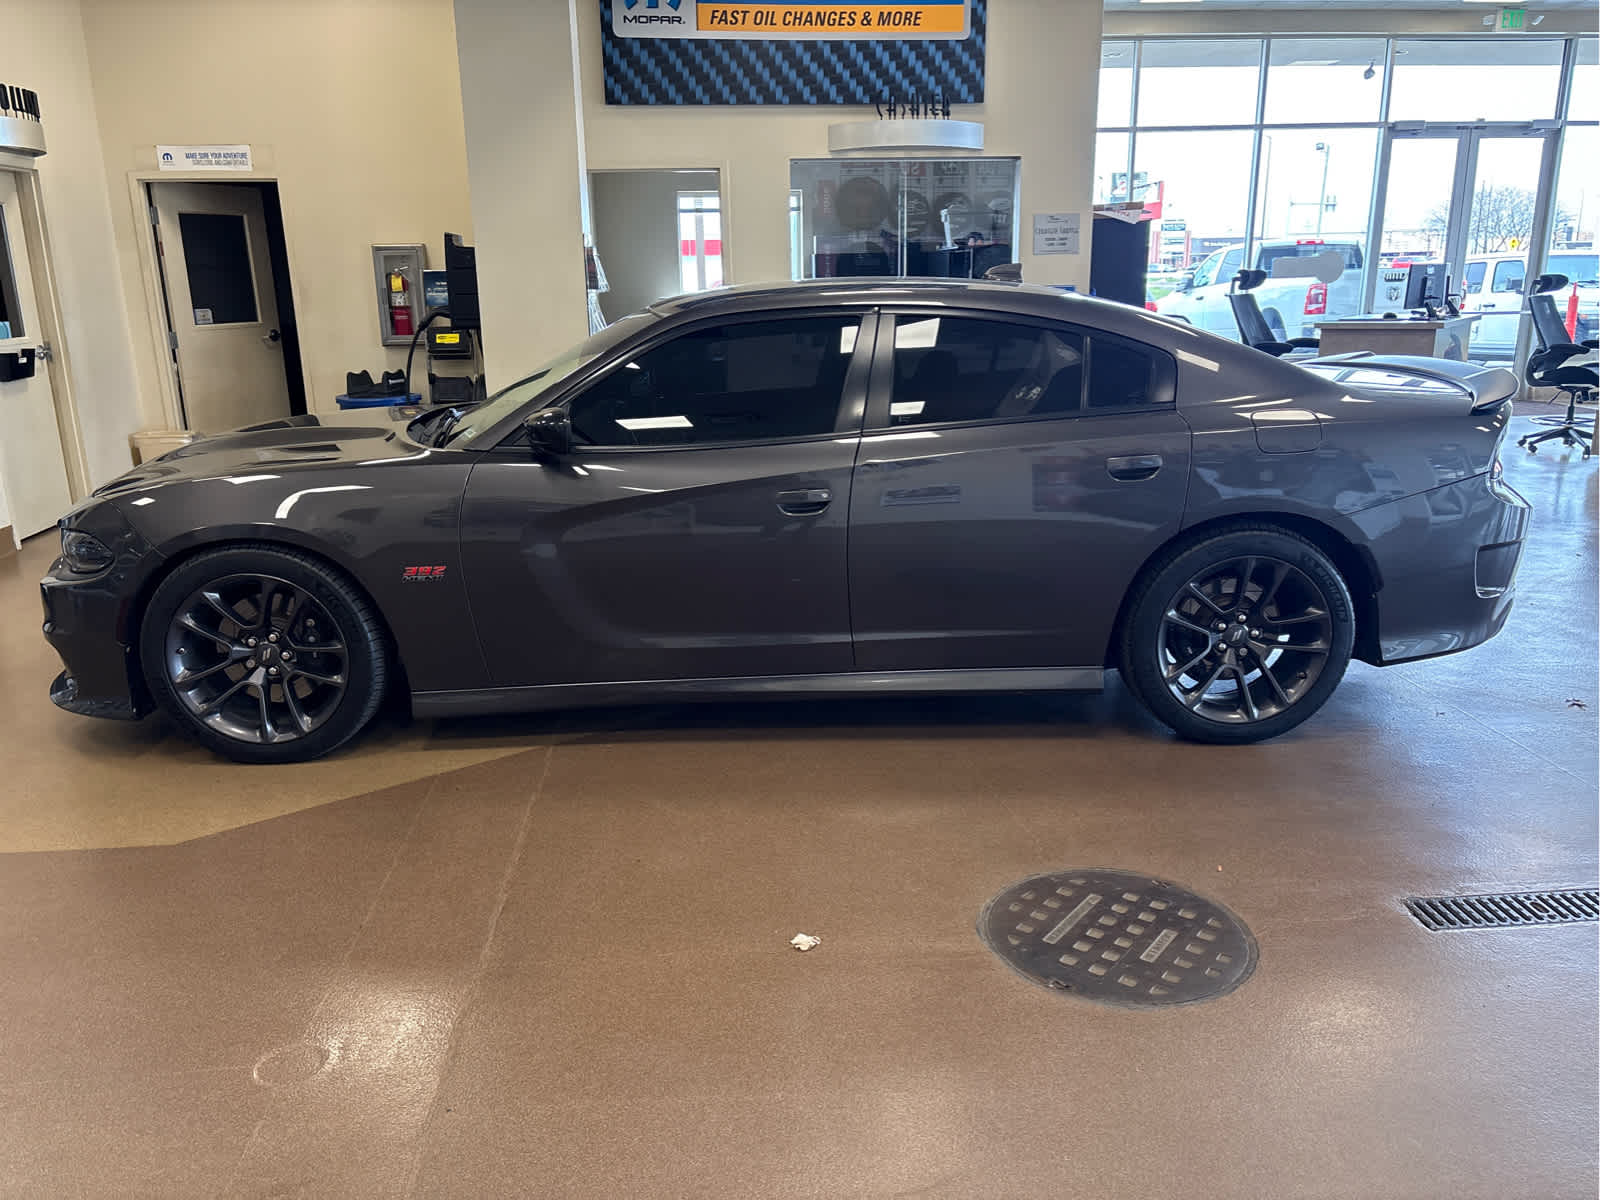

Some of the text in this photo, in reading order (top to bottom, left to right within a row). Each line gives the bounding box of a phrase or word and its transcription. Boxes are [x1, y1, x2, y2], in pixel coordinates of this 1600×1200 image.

[623, 15, 683, 25] MOPAR
[710, 9, 923, 27] FAST OIL CHANGES & MORE
[1501, 9, 1526, 29] EXIT
[403, 565, 447, 577] 392
